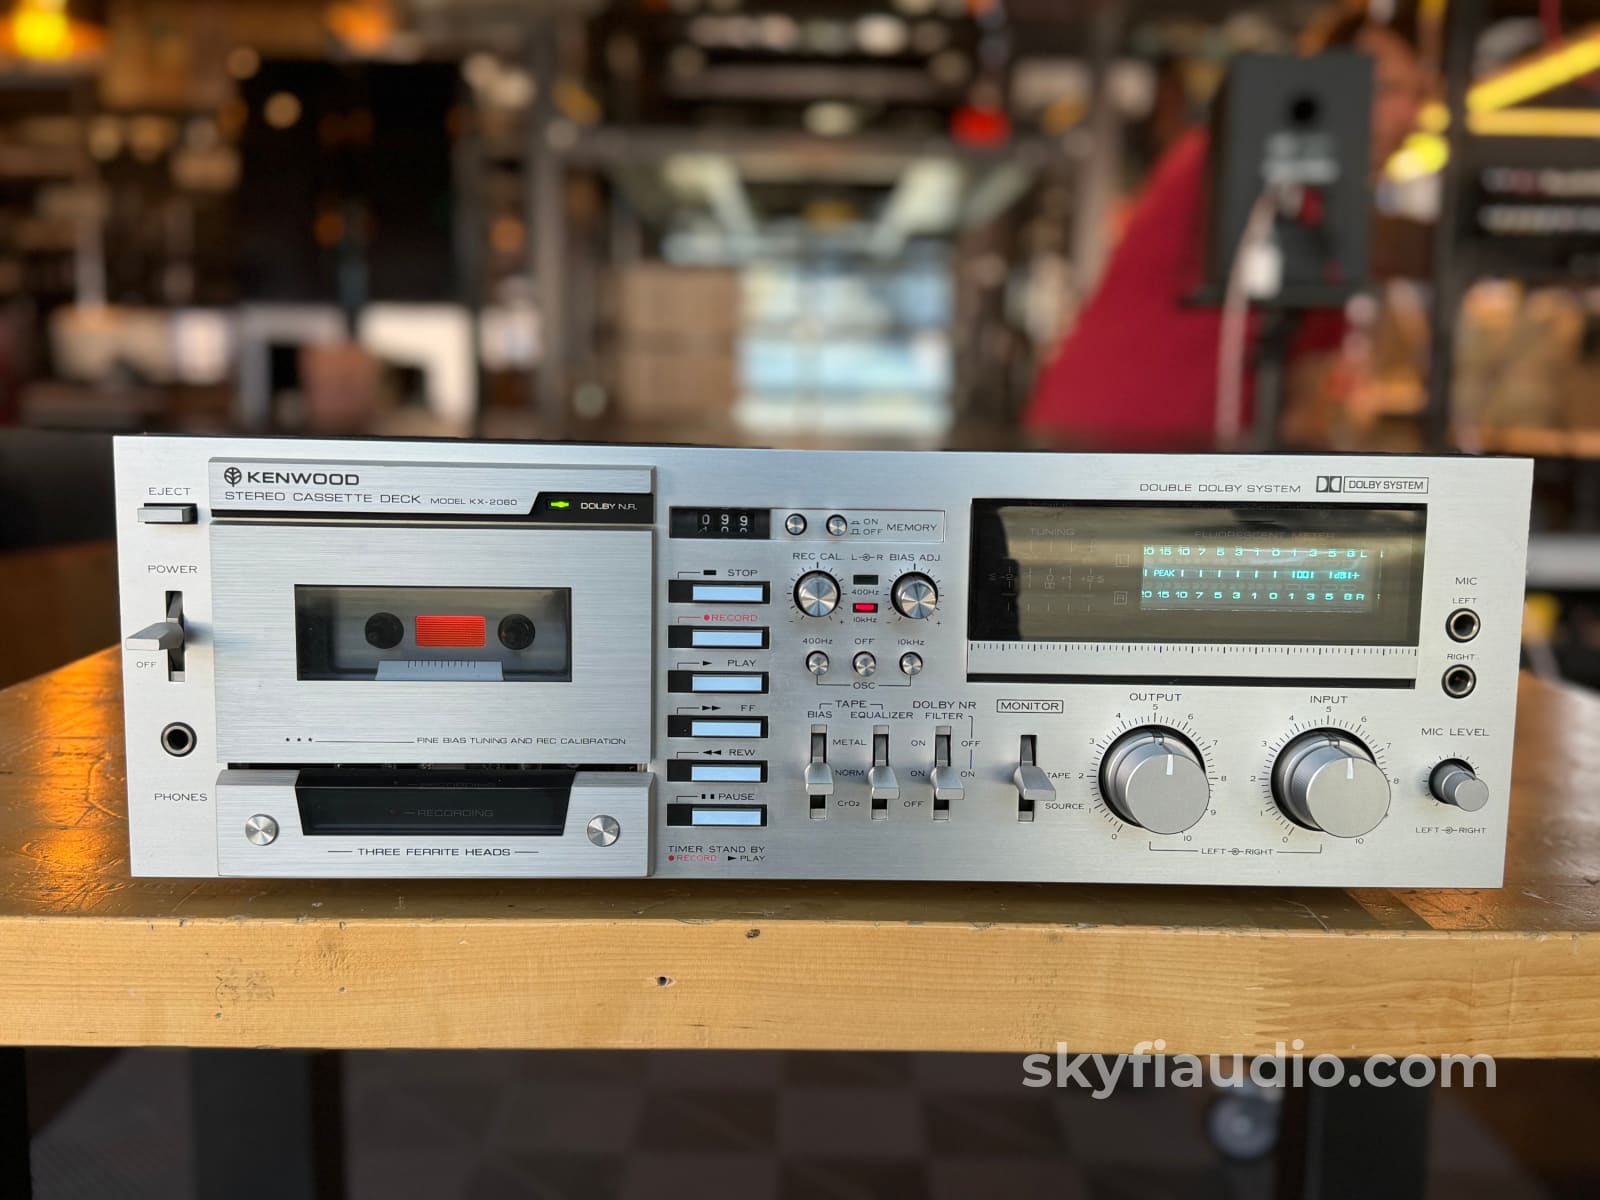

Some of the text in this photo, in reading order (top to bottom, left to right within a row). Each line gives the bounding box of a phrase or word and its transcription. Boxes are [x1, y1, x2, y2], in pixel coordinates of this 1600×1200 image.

[247, 472, 360, 486] KENWOOD
[1140, 484, 1301, 493] DOUBLE DOLBY SYSTEM
[1348, 480, 1424, 490] DOLBY SYSTEM
[148, 488, 191, 496] EJECT
[224, 491, 421, 504] STEREO CASSETTE DECK
[886, 524, 938, 532] MEMORY
[1178, 546, 1190, 556] 10
[1272, 548, 1280, 556] 0
[148, 565, 198, 574] POWER
[728, 569, 758, 577] STOP
[1456, 577, 1478, 586] MIC
[1129, 694, 1182, 702] OUTPUT
[1310, 696, 1348, 704] INPUT
[835, 700, 867, 708] TAPE
[912, 701, 954, 710] DOLBY
[1000, 702, 1059, 711] MONITOR
[808, 710, 832, 718] BIAS
[1421, 728, 1444, 736] MIC
[154, 792, 208, 801] PHONES
[417, 809, 494, 817] RECORDING
[708, 846, 746, 854] STAND
